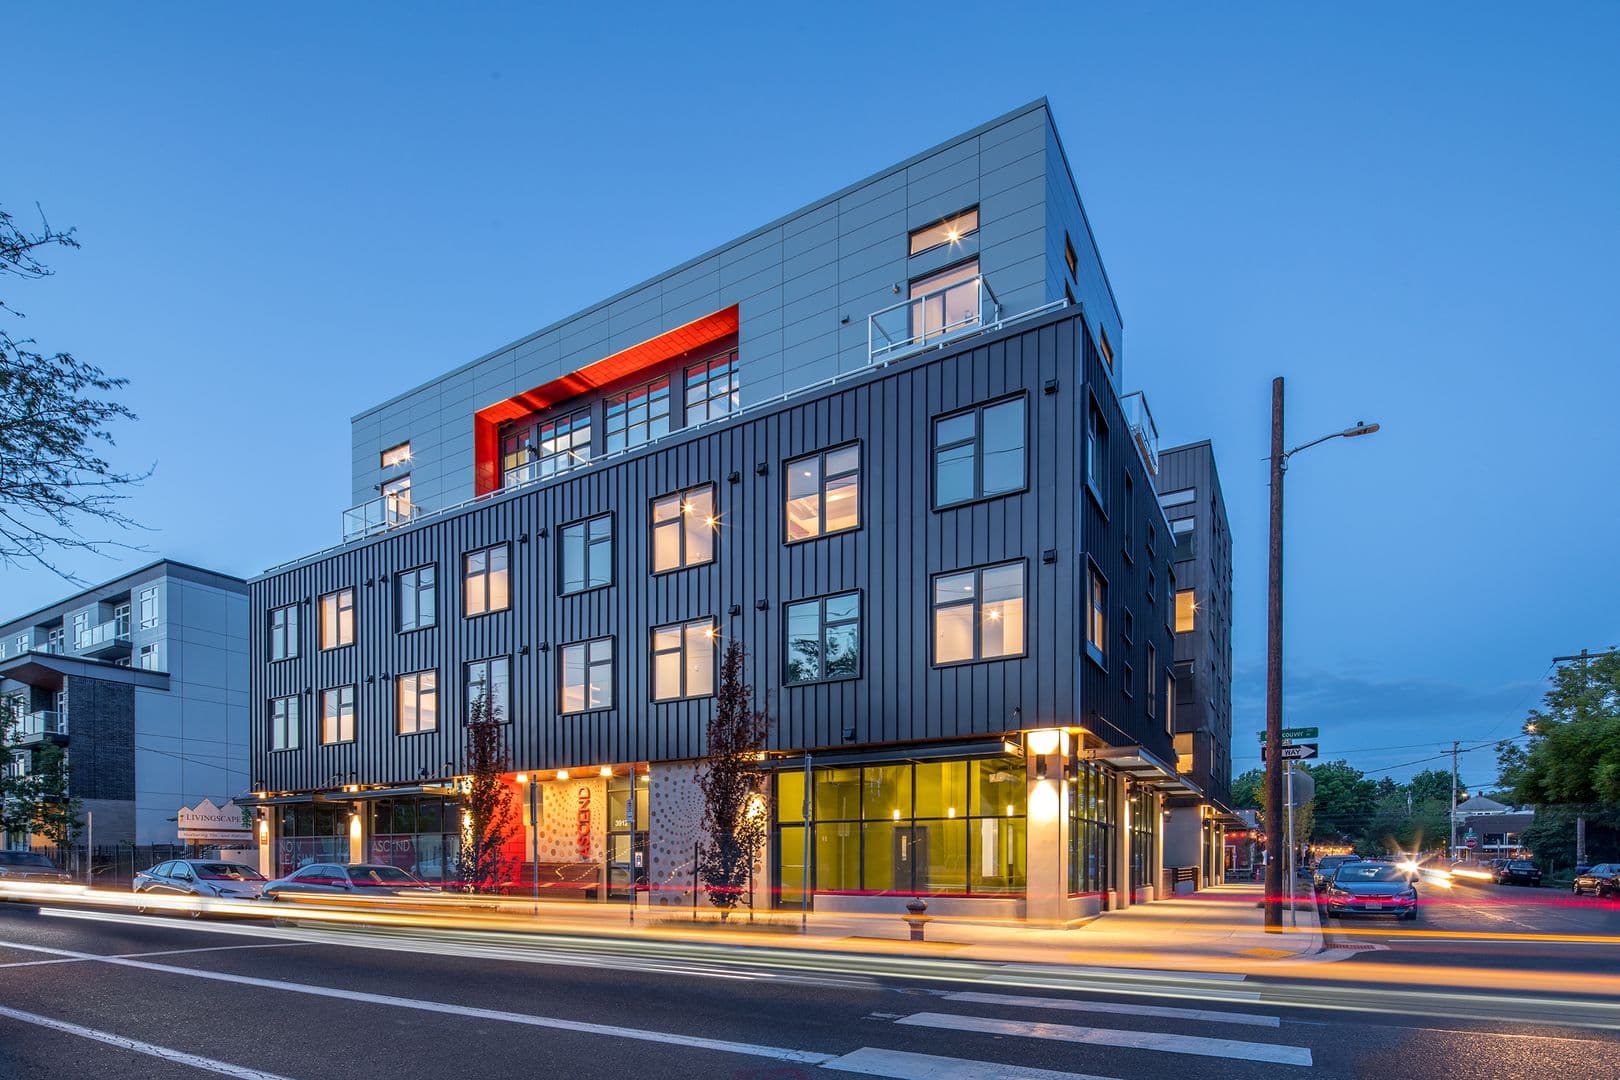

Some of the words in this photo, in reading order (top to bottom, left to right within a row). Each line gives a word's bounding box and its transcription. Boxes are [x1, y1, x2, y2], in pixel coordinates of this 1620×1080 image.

[1284, 748, 1301, 756] WAY
[186, 814, 241, 823] LIVINGSCAPE
[577, 786, 591, 858] ASCEND
